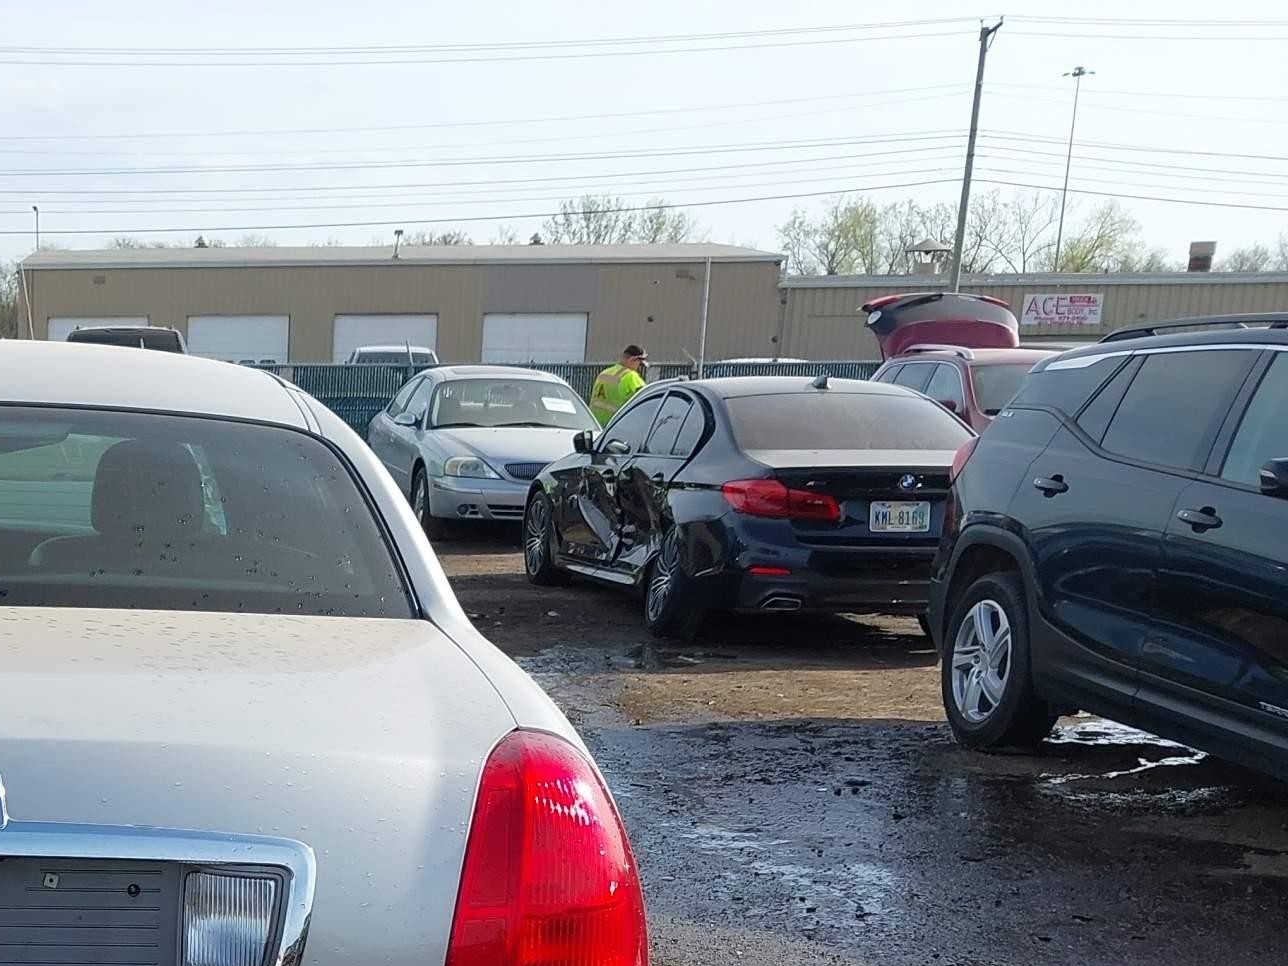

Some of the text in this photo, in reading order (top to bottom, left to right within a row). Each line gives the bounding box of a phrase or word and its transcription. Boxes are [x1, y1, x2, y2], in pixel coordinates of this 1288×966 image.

[1025, 296, 1068, 315] ACE
[874, 510, 925, 526] KML 8169
